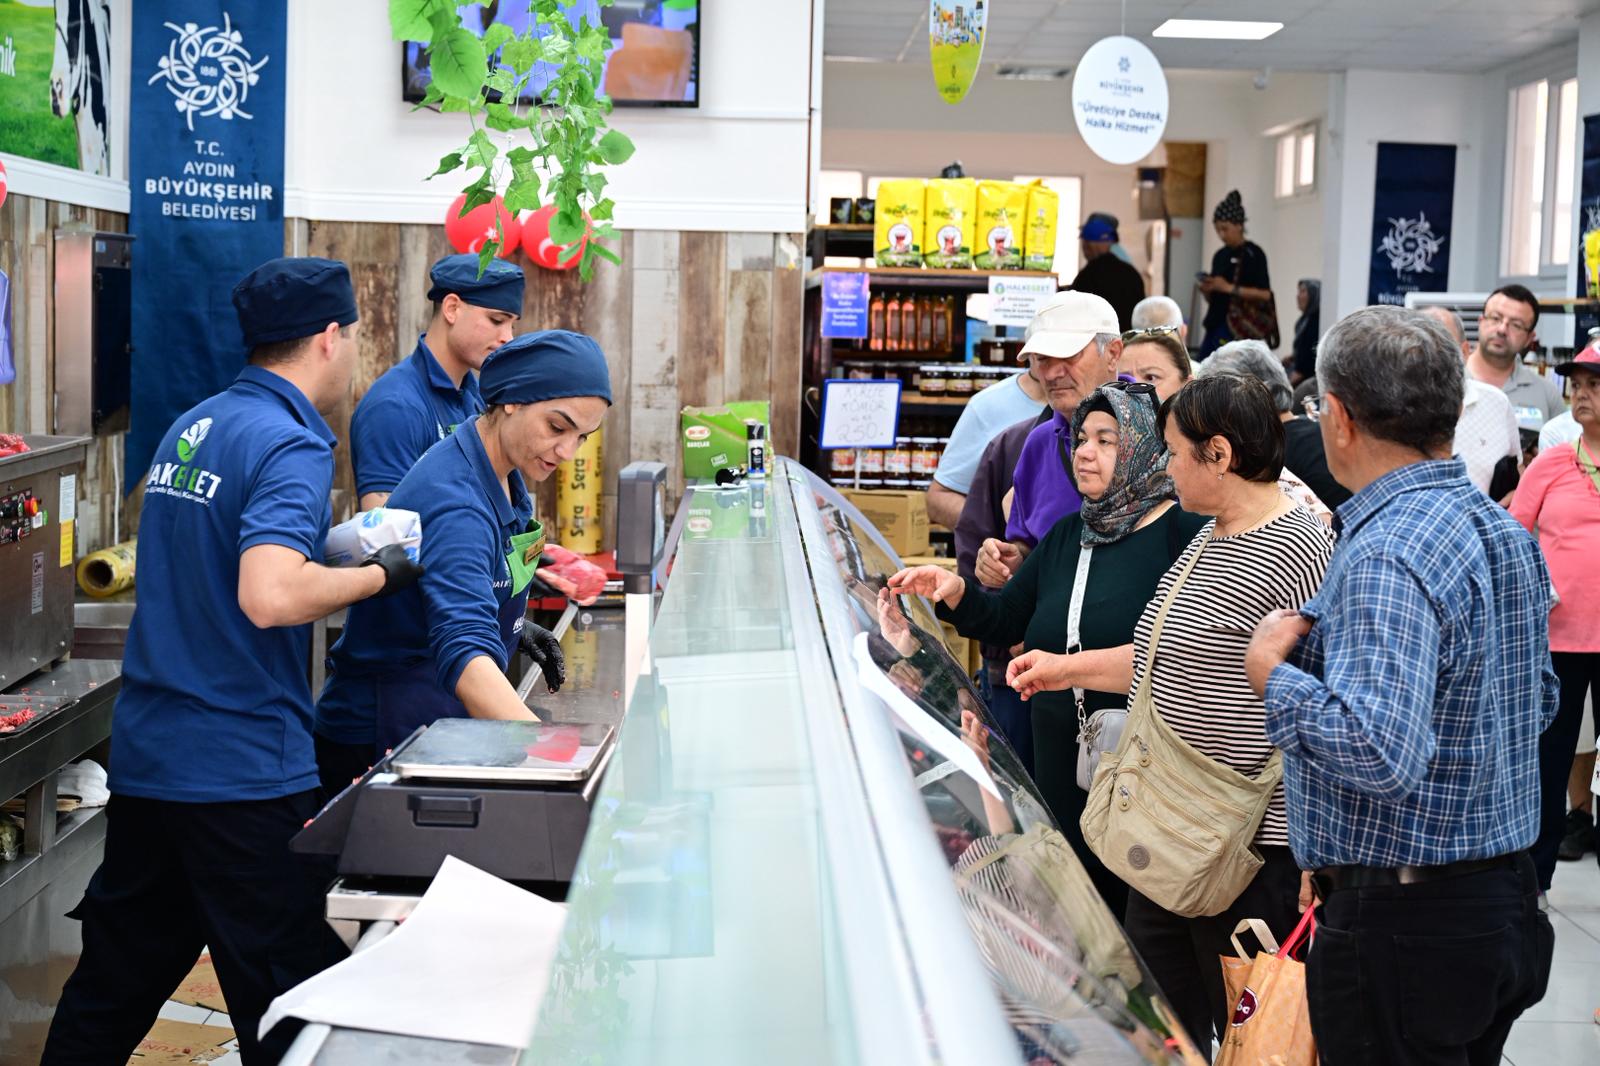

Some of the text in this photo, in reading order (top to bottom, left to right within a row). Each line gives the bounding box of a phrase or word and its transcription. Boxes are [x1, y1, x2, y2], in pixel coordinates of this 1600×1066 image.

[1085, 118, 1112, 129] Halka
[194, 140, 224, 156] T.C.
[183, 161, 235, 178] AYDIN
[145, 178, 273, 203] BÜYÜKŞEHİR
[162, 202, 257, 221] BELEDİYESİ
[571, 458, 585, 490] Sera
